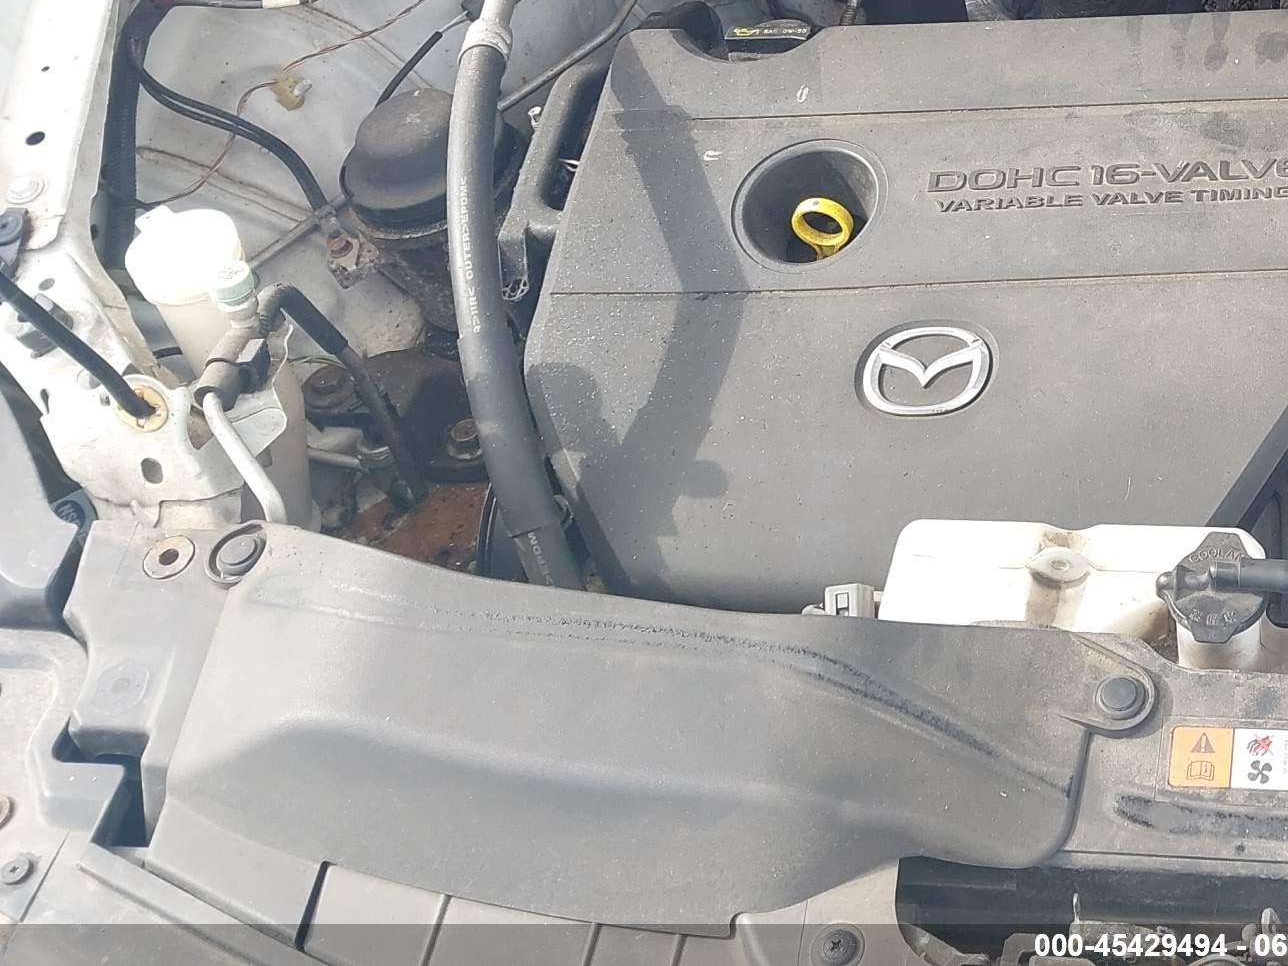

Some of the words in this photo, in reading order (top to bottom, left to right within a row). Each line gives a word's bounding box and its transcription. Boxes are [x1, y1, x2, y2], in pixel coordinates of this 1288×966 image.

[927, 165, 1083, 193] DOHC
[936, 193, 1083, 213] VARIABLE
[1091, 189, 1184, 207] VALVE
